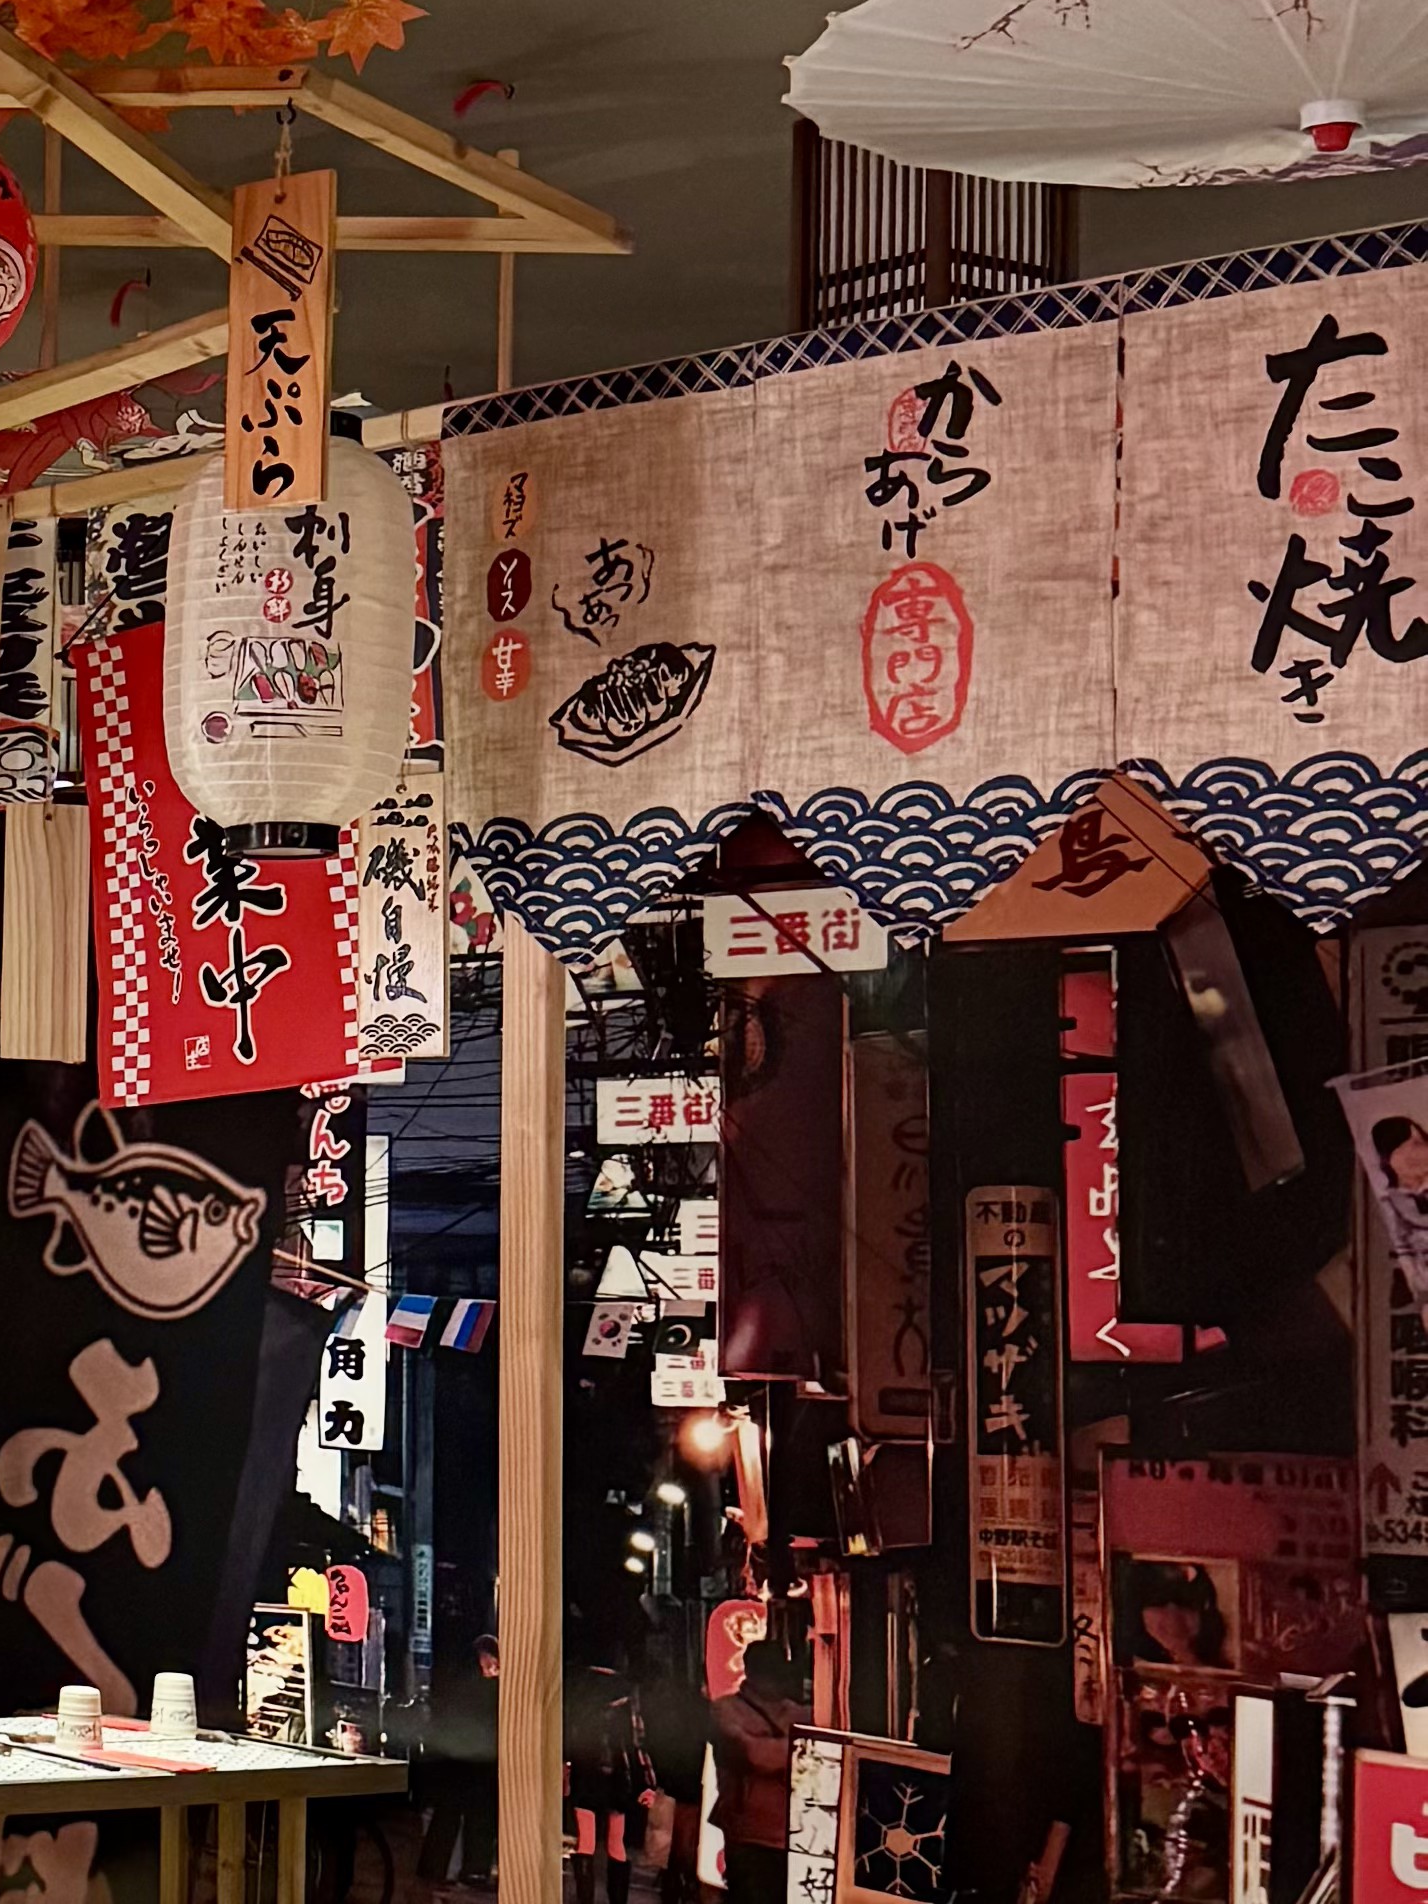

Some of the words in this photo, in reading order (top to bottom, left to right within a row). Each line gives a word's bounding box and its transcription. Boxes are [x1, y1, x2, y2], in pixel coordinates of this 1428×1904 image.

[241, 309, 312, 499] 天ぷら
[864, 359, 1004, 559] からあげ
[284, 504, 351, 641] 刺身
[499, 557, 519, 617] ソース
[1248, 311, 1428, 724] たこ焼き
[362, 837, 428, 1005] 磯自慢
[727, 906, 862, 958] 三番街
